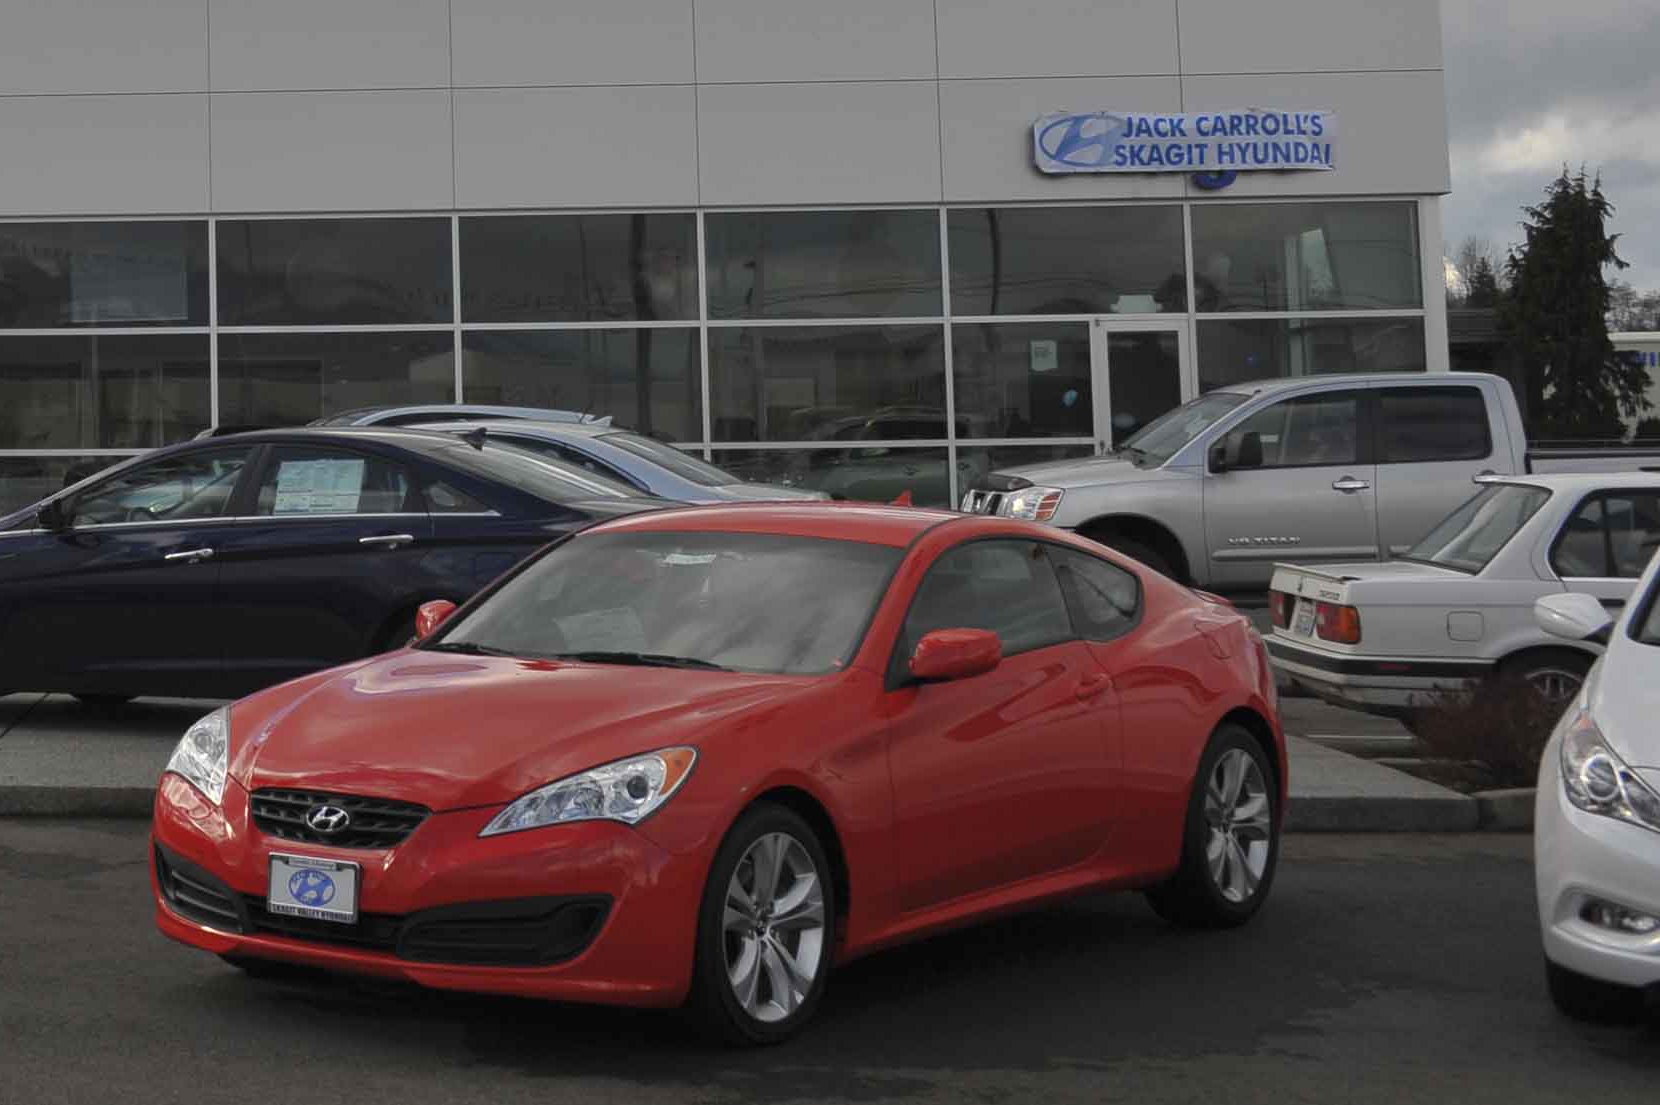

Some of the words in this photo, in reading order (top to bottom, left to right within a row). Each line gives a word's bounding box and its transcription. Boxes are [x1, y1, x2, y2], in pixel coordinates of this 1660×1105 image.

[1121, 117, 1186, 138] JACK
[1195, 114, 1323, 137] CARROLL'S
[1114, 143, 1207, 166] SKAGIT
[1217, 141, 1332, 165] HYUNDAI
